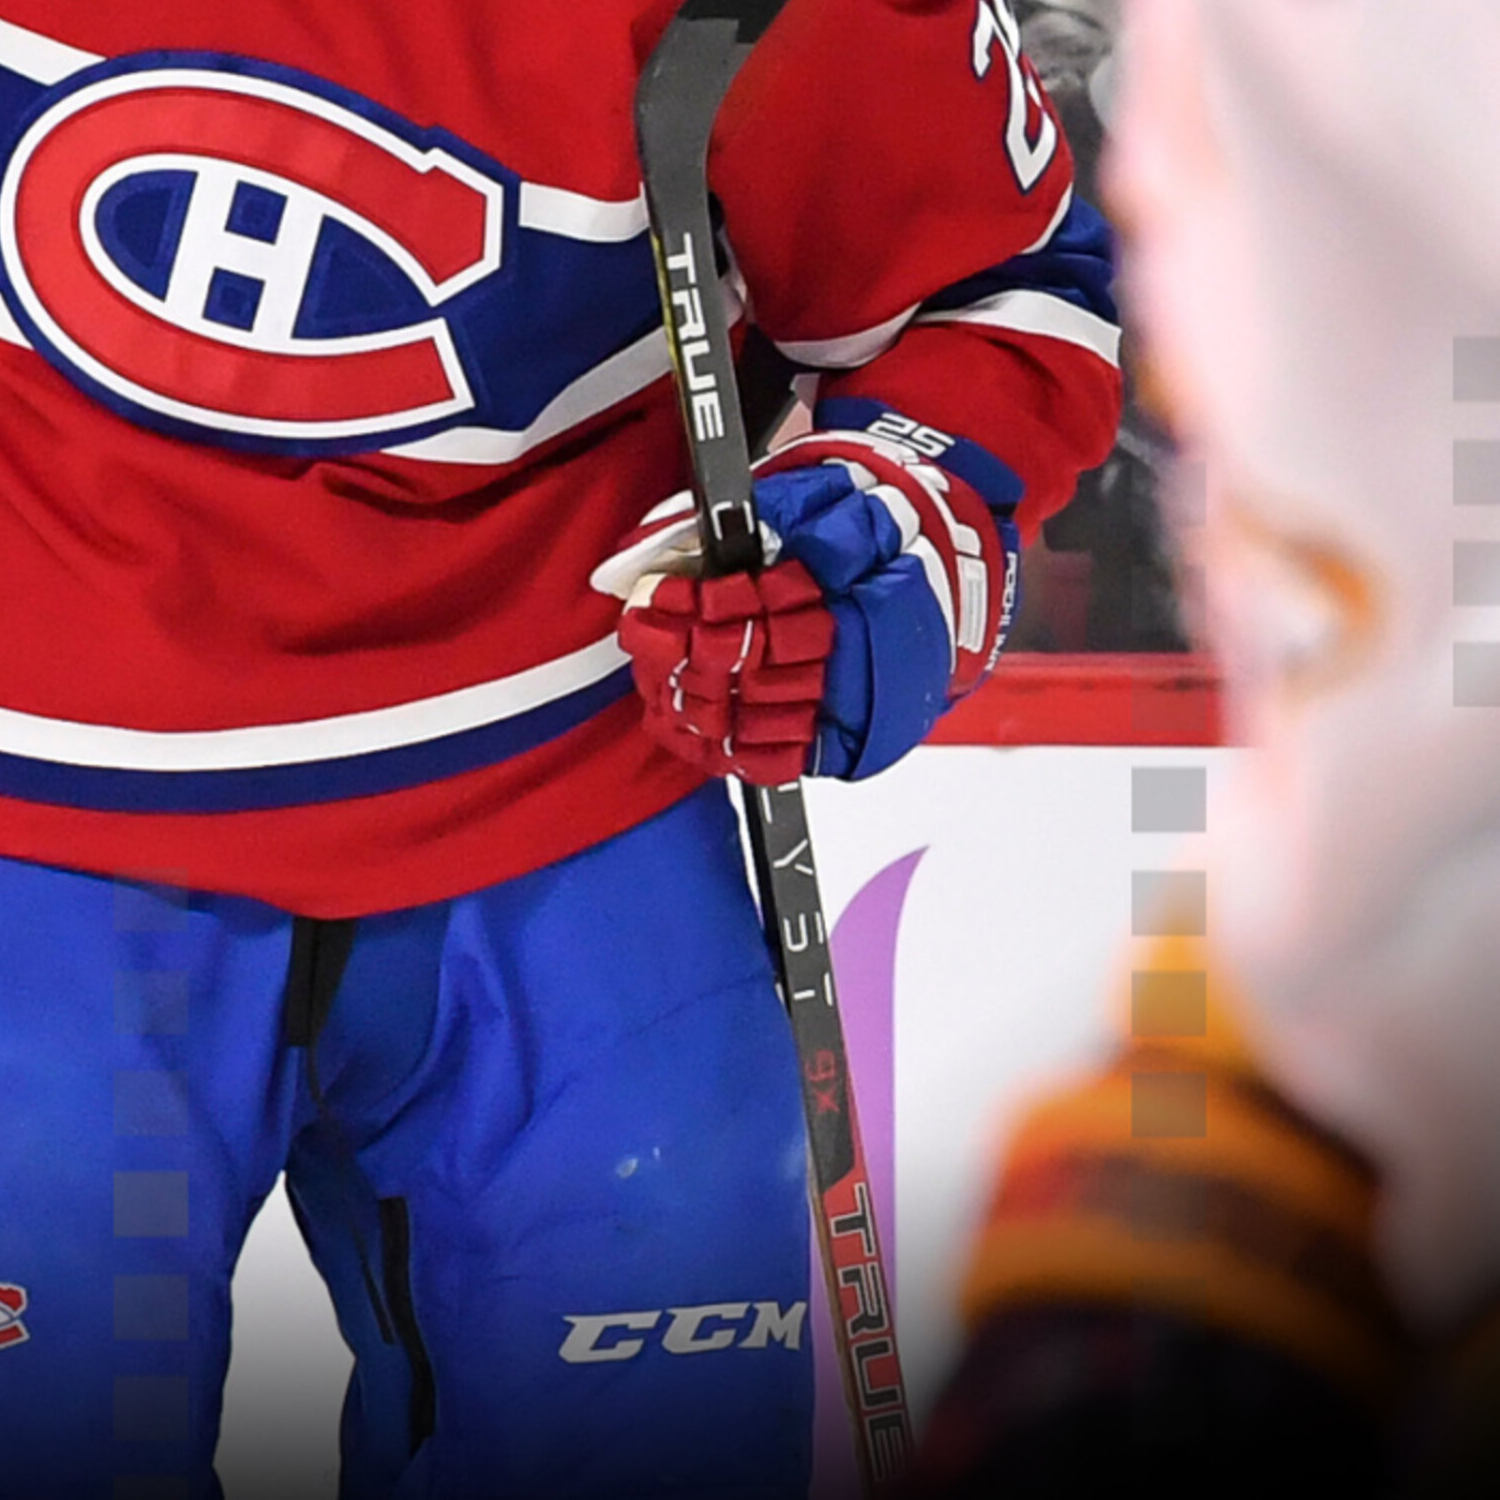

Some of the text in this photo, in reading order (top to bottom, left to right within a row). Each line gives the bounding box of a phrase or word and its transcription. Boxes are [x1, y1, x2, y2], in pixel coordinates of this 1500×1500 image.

[666, 233, 725, 441] TRUE
[867, 412, 956, 458] 25
[558, 1301, 807, 1364] CCM
[831, 1182, 908, 1482] TRUE
